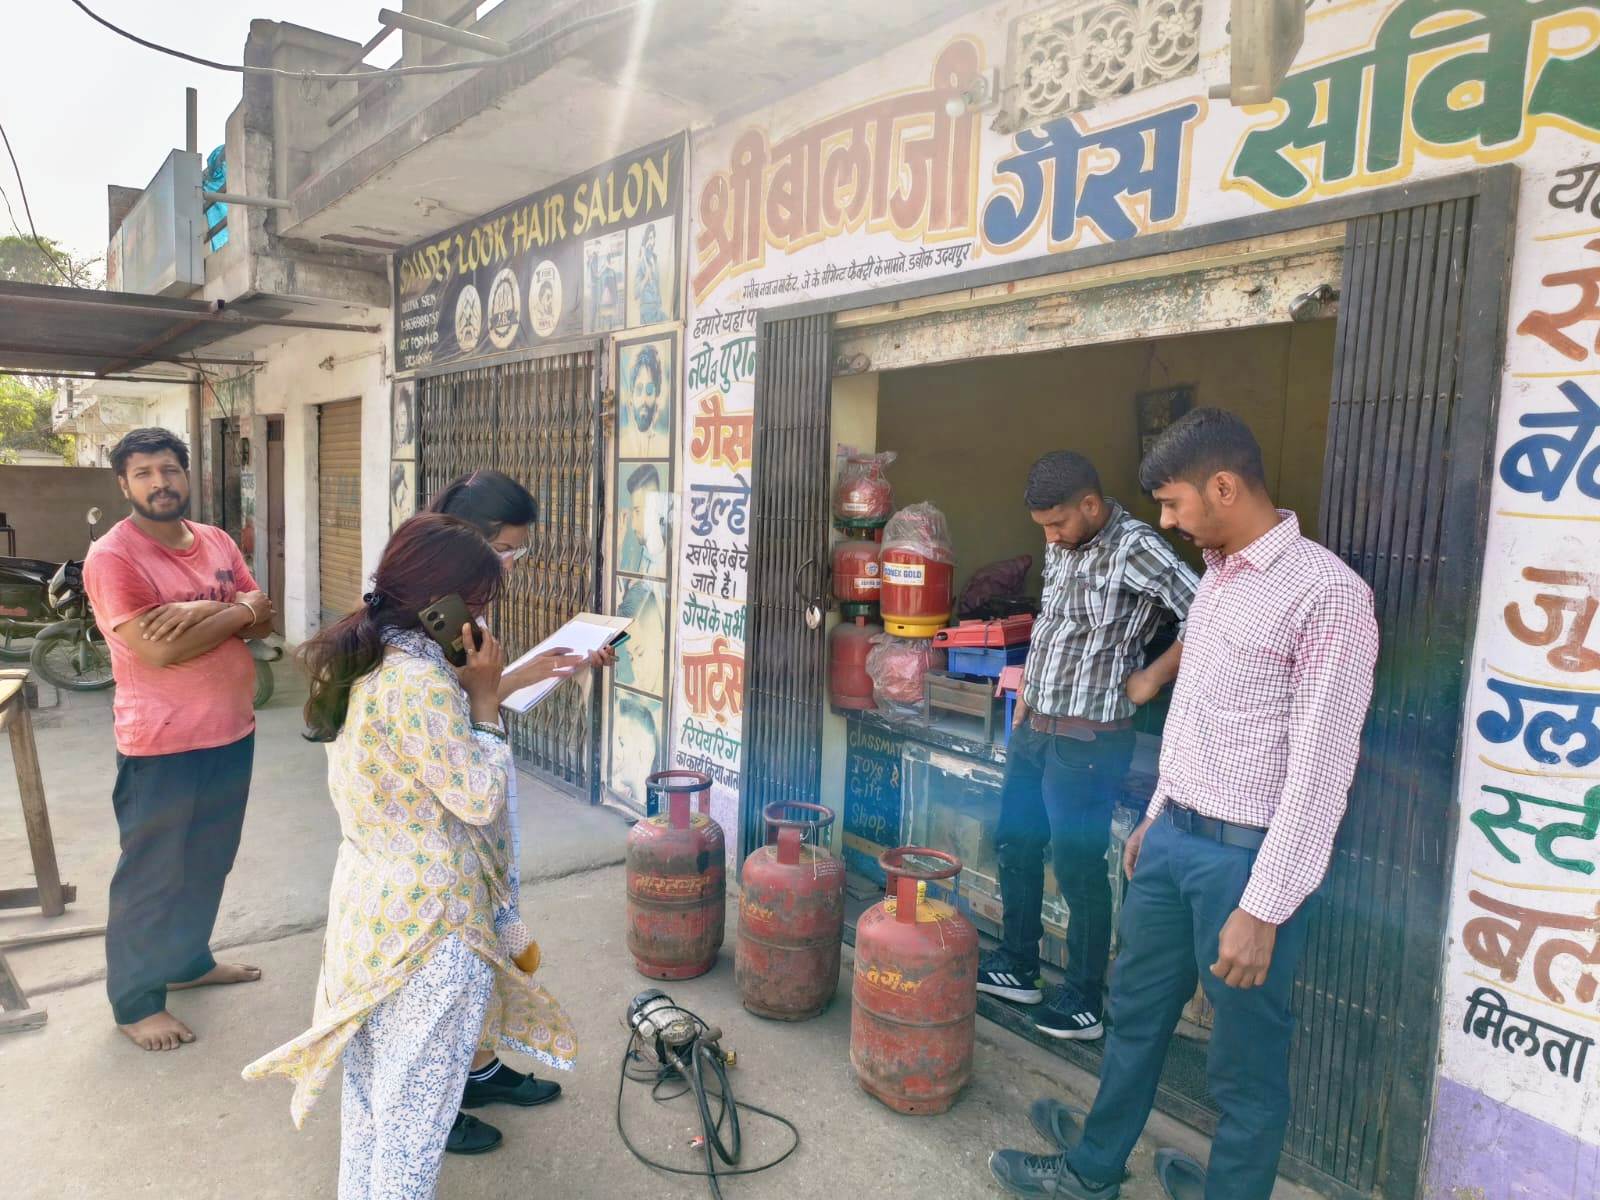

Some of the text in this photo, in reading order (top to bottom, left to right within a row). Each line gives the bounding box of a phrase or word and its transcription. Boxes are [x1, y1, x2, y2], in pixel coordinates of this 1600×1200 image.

[455, 216, 508, 275] LOOK
[512, 193, 567, 256] HAIR
[573, 148, 669, 237] SALON
[934, 243, 972, 269] उदयपुर
[690, 394, 754, 468] गैस
[690, 473, 752, 536] चुल्हे
[1463, 987, 1595, 1083] मिलता
